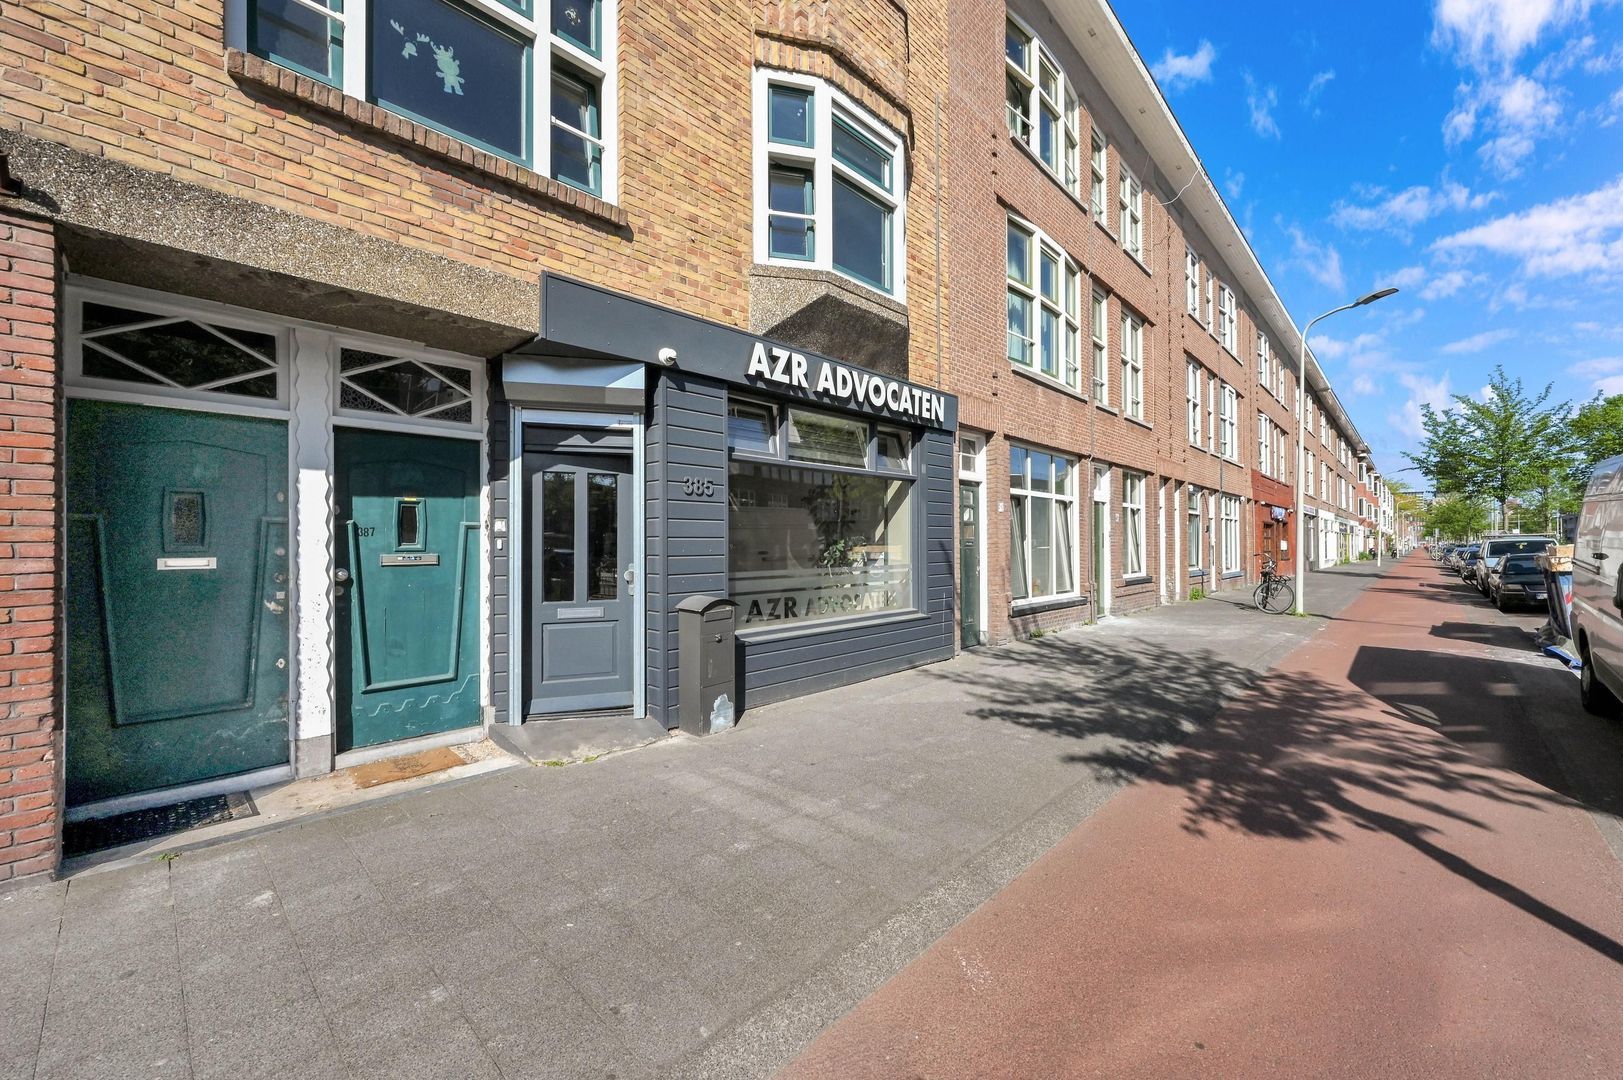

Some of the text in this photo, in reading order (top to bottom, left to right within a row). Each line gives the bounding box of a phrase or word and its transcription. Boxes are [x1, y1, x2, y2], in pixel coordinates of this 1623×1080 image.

[747, 341, 945, 423] AZR ADVOCATEN
[683, 475, 714, 497] 385
[358, 526, 375, 537] 387
[745, 596, 798, 623] AZR
